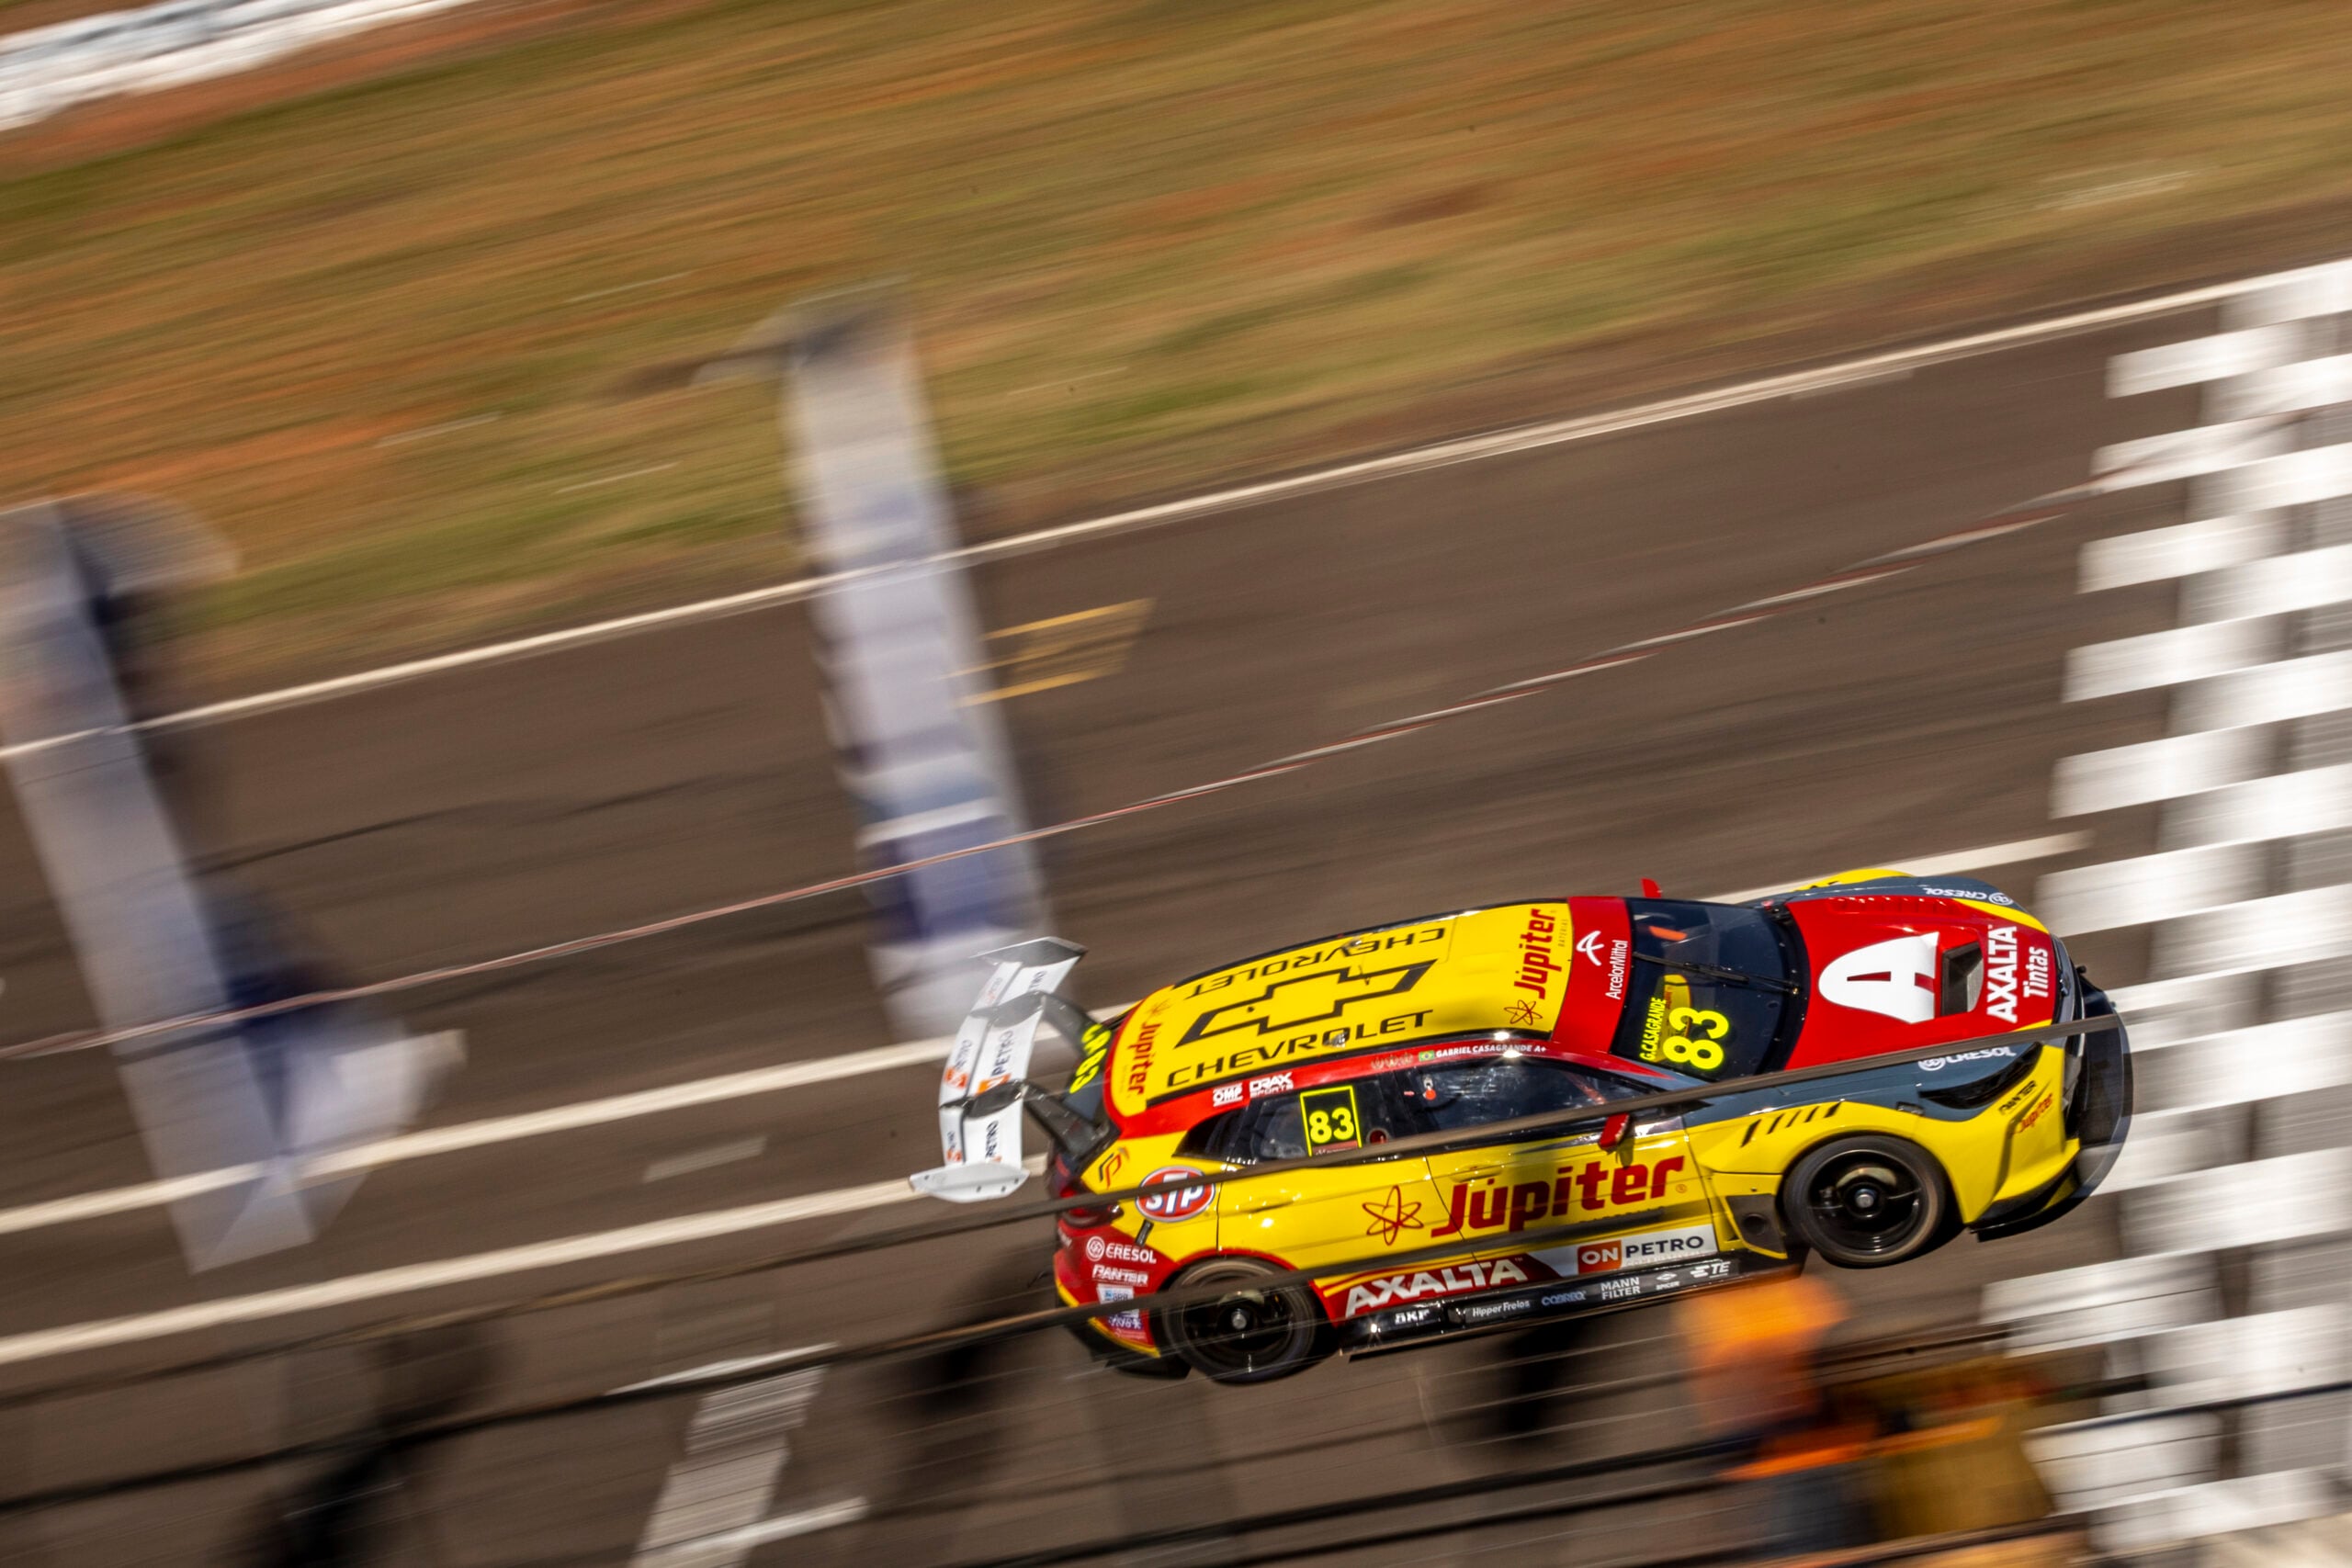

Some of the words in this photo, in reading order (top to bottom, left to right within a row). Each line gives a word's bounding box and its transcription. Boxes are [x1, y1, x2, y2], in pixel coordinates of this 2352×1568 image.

[1922, 887, 1987, 900] CRESOL
[1182, 927, 1445, 1000] CHEVROLET
[1605, 940, 1629, 1000] ArcelorMittal
[1986, 925, 2018, 1024] AXALTA
[2022, 946, 2049, 998] Tintas
[1167, 1009, 1433, 1088] CHEVROLET
[1436, 1044, 1472, 1058] GABRIEL
[1473, 1044, 1532, 1054] CASAGRANDE
[1663, 1007, 1729, 1070] 83
[1213, 1084, 1243, 1103] OMP
[1250, 1072, 1293, 1091] DRAX
[1308, 1106, 1355, 1144] 83
[1145, 1172, 1204, 1214] STP
[1430, 1155, 1684, 1237] Júpiter
[1105, 1242, 1157, 1264] CRESOL
[1581, 1246, 1619, 1265] ON
[1625, 1235, 1704, 1258] PETRO
[1345, 1258, 1529, 1319] AXALTA
[1600, 1276, 1640, 1292] MANN
[1601, 1285, 1641, 1301] FILTER
[1472, 1304, 1502, 1317] Hipper
[1503, 1299, 1531, 1312] Freios
